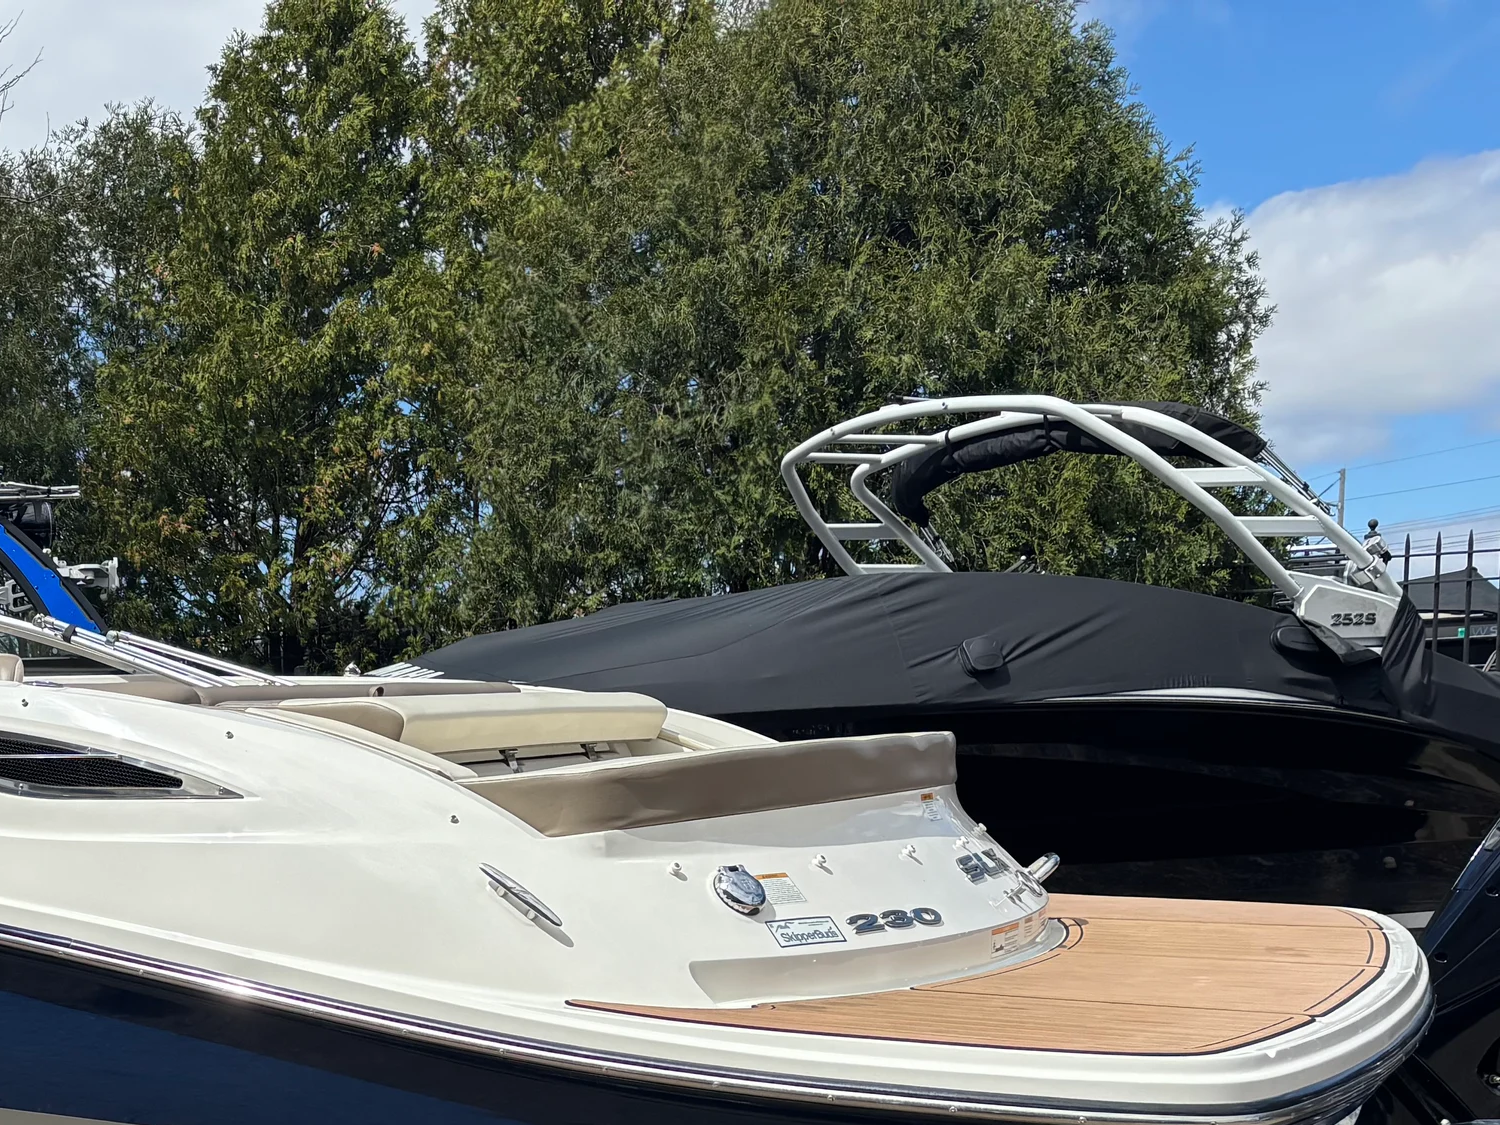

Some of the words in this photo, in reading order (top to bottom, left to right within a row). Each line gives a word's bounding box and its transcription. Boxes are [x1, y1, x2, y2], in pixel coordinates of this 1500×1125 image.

[955, 848, 1013, 884] SLX
[781, 926, 840, 944] SkipperBud's
[845, 907, 943, 935] 230
